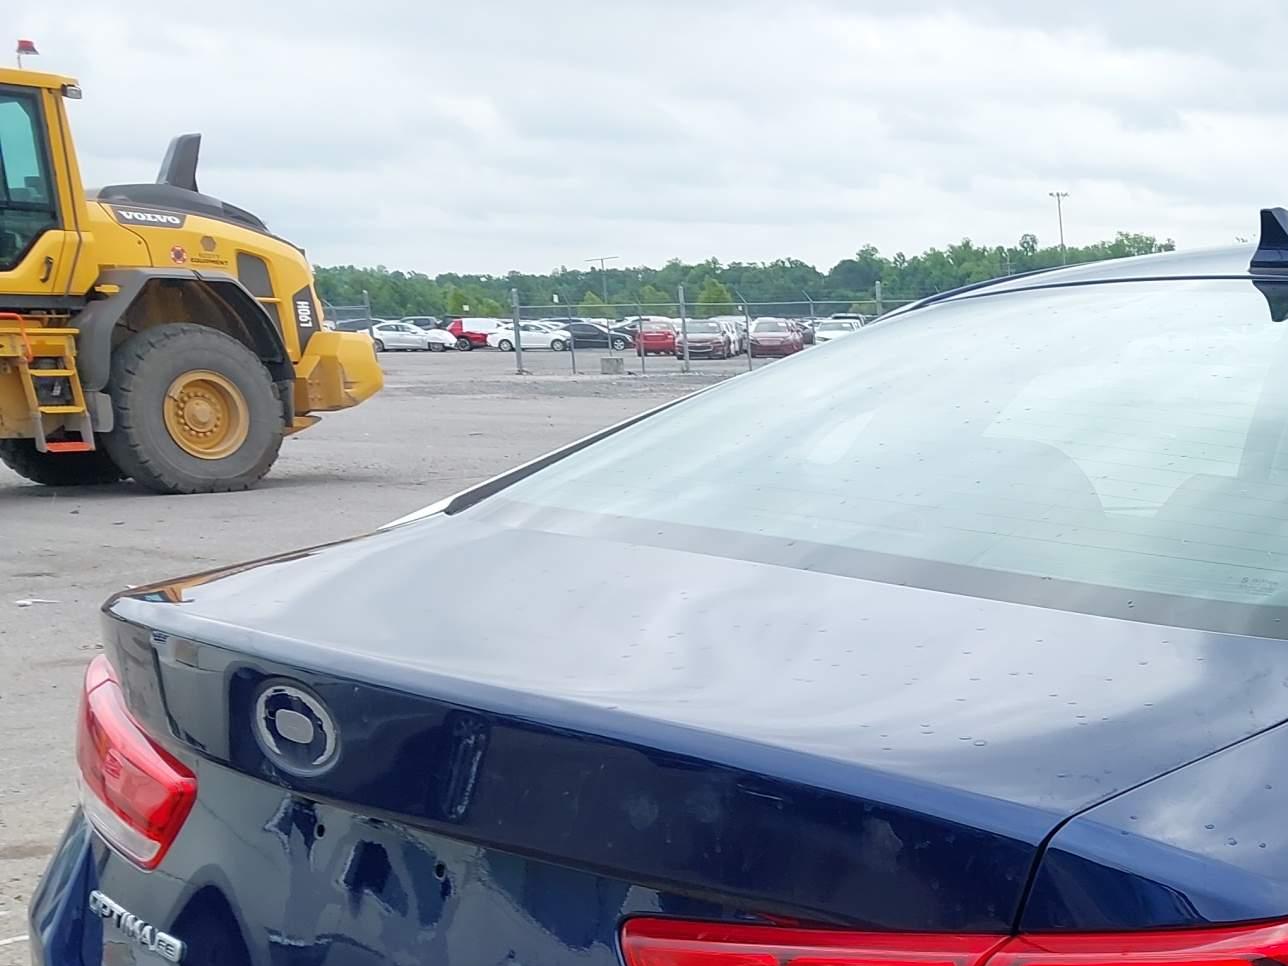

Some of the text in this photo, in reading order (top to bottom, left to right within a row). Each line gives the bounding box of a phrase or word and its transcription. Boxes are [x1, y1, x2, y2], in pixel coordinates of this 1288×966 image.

[119, 210, 181, 224] VOLVO
[295, 300, 313, 328] L90H
[88, 889, 157, 951] OPTIMA
